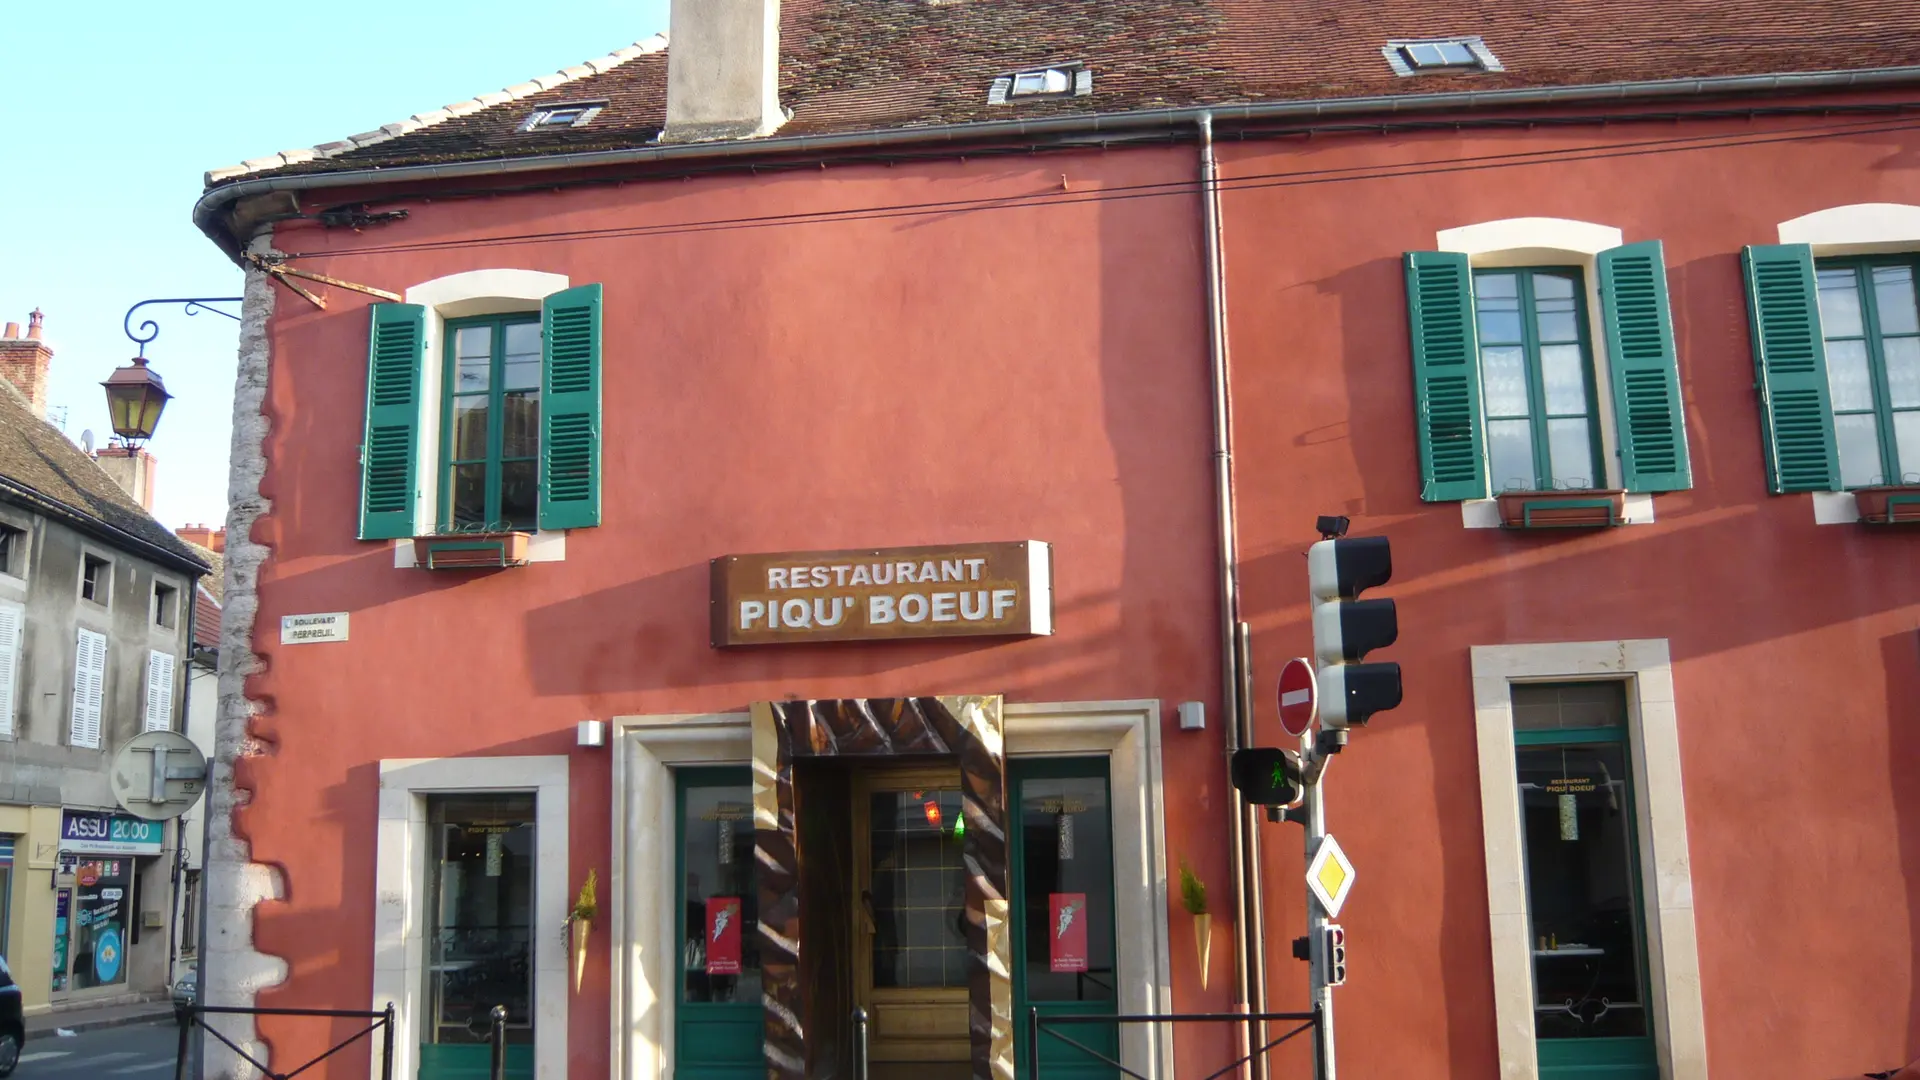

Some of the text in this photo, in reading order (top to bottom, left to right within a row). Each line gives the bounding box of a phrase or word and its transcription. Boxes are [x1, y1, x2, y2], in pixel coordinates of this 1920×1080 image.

[768, 558, 985, 589] RESTAURANT
[740, 589, 1016, 629] PIQU' BOEUF
[294, 616, 336, 626] BOULEVARD
[292, 628, 335, 639] PERPREUIL
[67, 817, 149, 839] ASSU 2000
